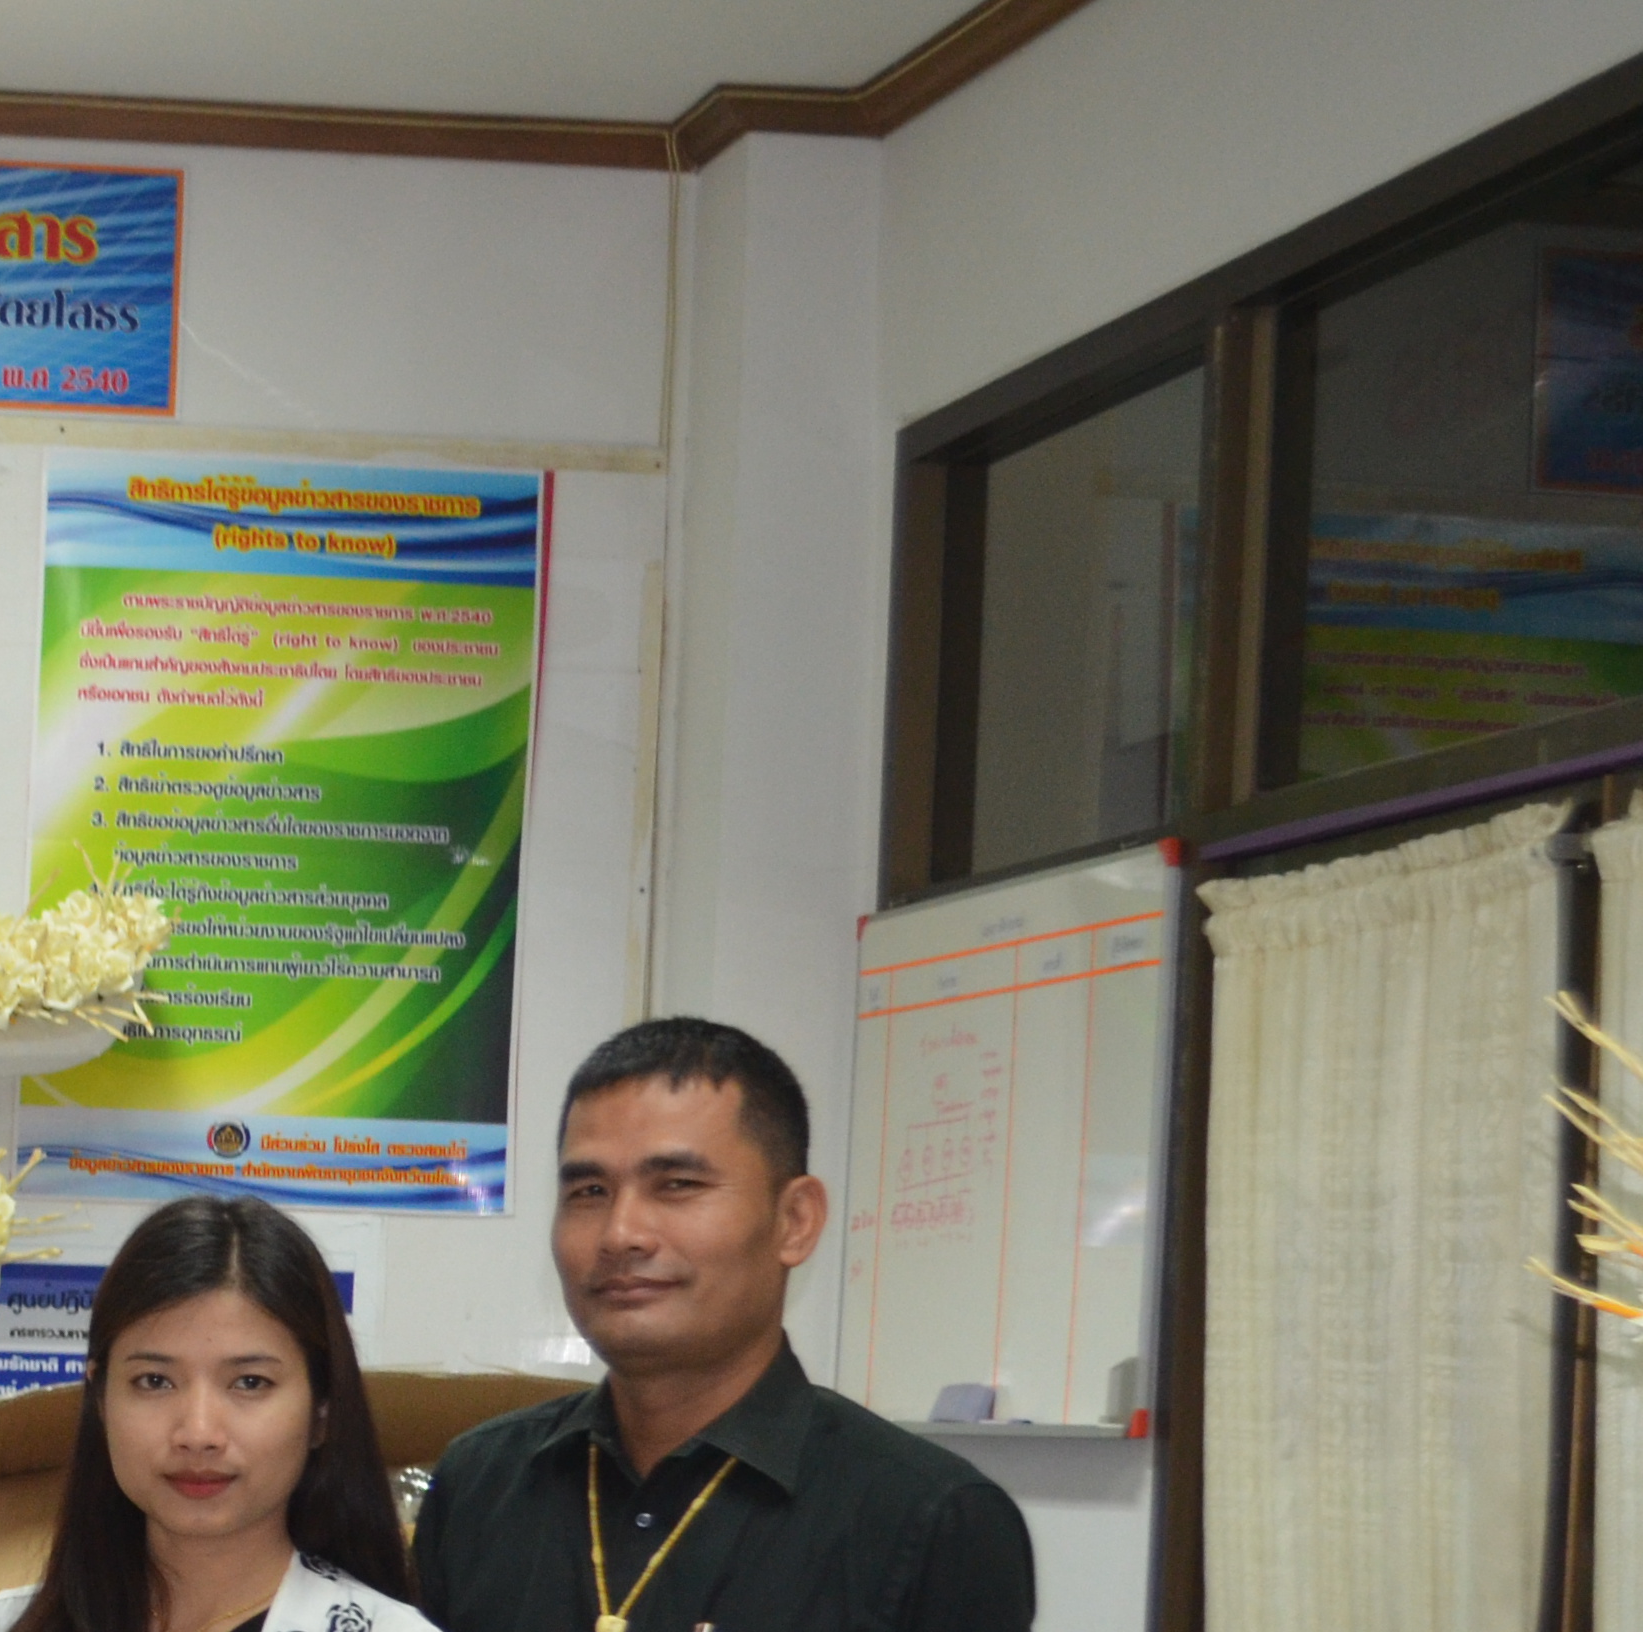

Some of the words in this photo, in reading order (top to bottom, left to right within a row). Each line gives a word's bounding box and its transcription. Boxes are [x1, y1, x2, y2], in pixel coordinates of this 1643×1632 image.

[60, 367, 129, 394] 2540
[213, 524, 289, 553] (rights
[292, 530, 321, 552] to
[325, 532, 398, 560] know)
[272, 631, 317, 650] (right
[325, 634, 342, 649] to
[349, 635, 400, 654] know)
